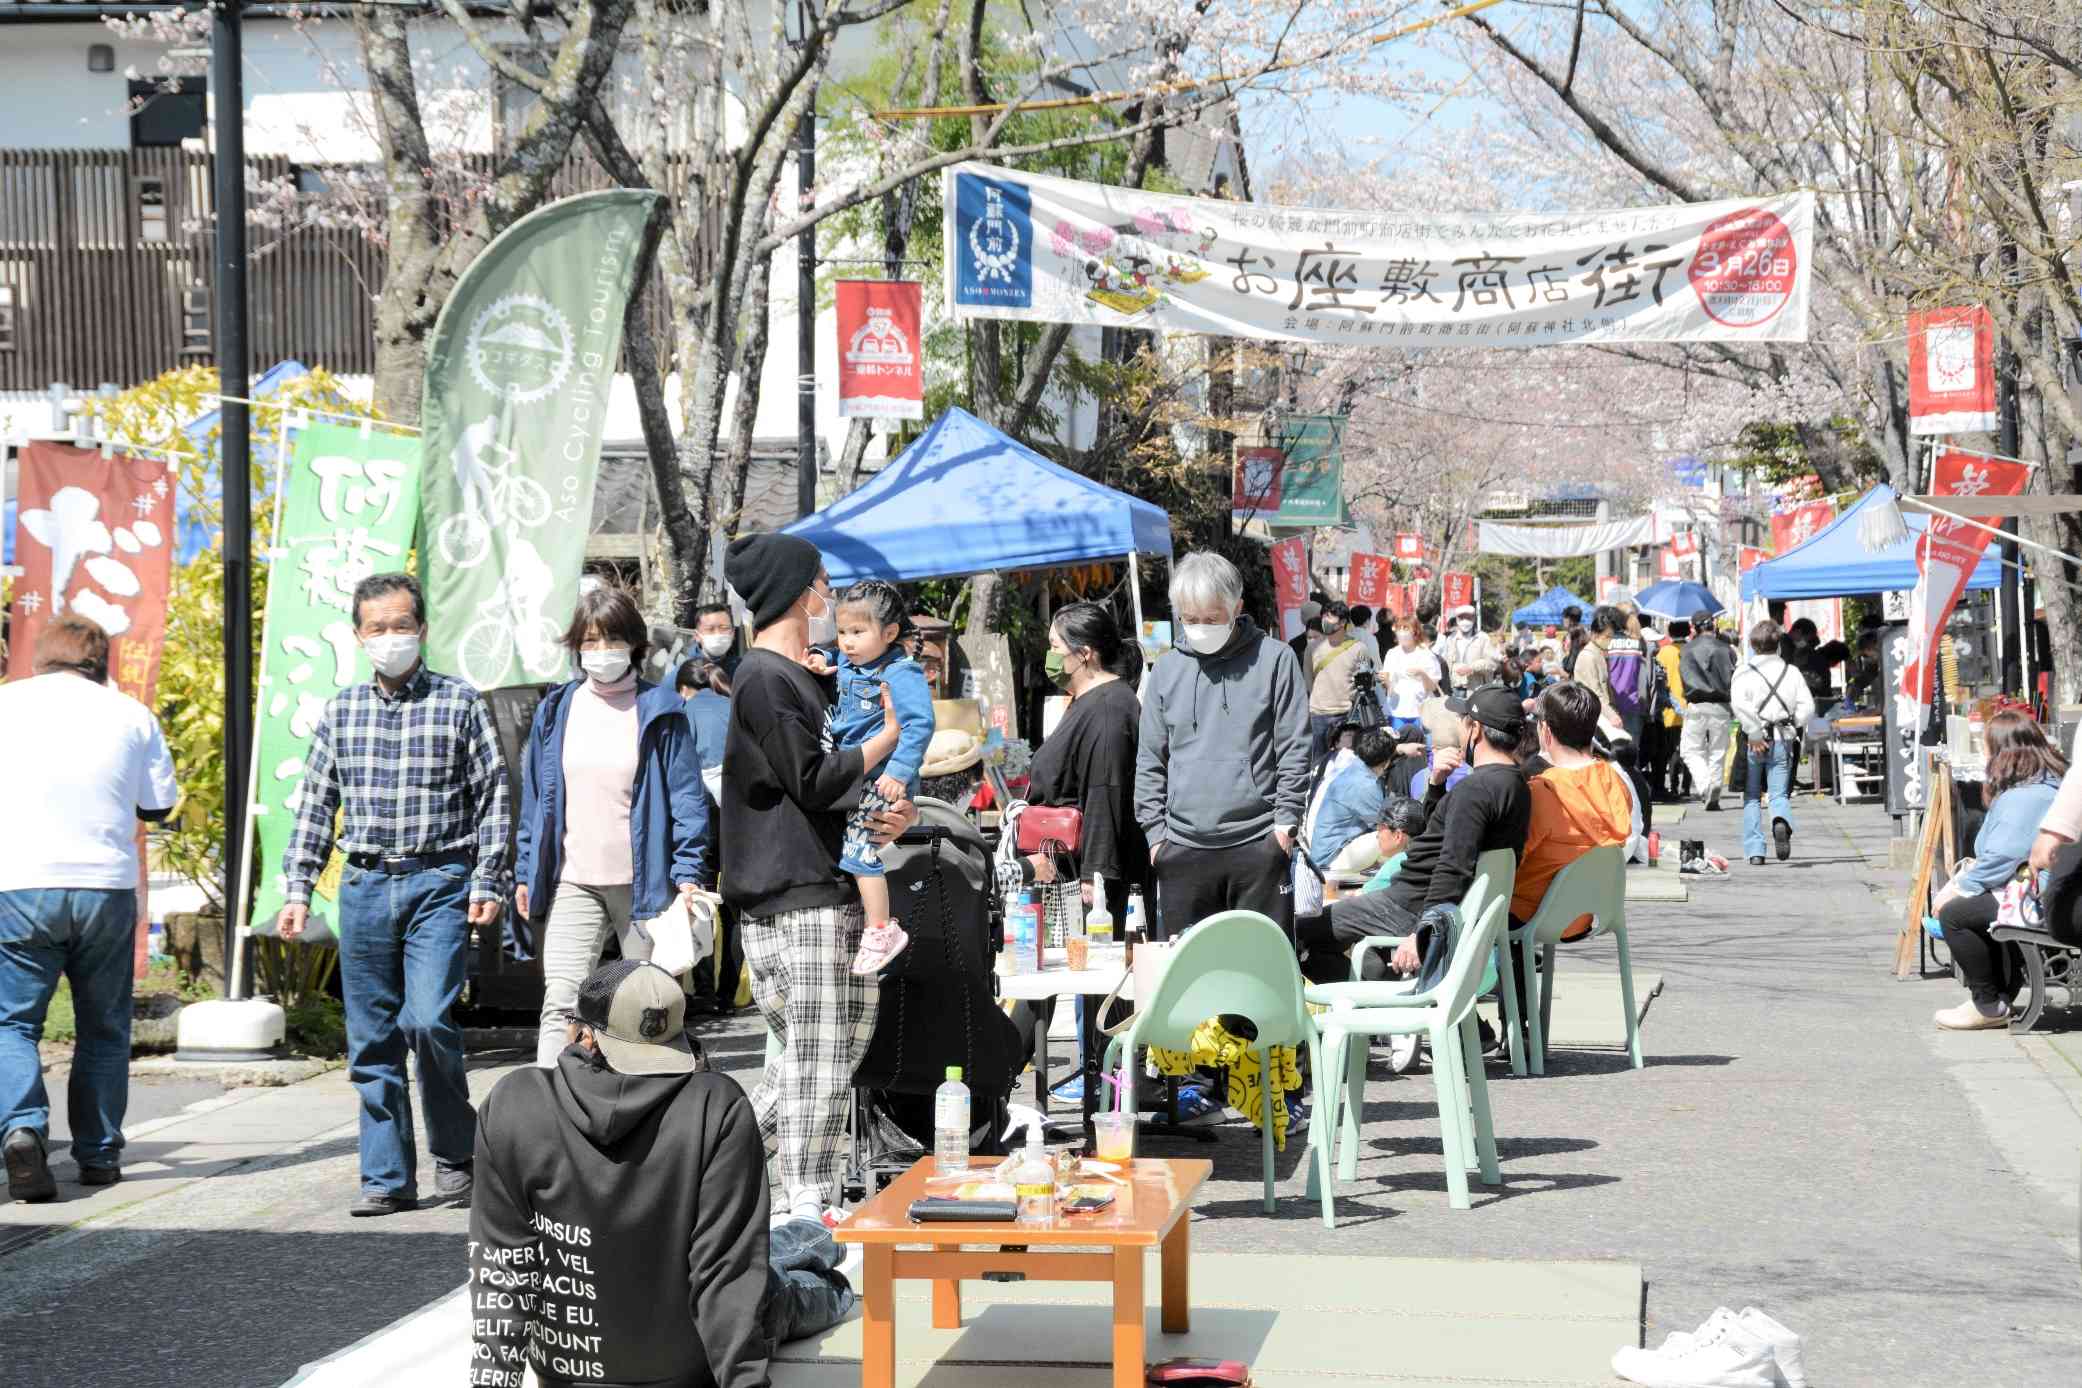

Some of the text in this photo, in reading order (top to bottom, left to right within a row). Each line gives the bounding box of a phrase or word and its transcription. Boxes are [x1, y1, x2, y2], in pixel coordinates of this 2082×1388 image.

[1695, 250, 1790, 277] 3月26日
[1226, 242, 1685, 313] お座敷商店街
[554, 229, 628, 522] Aso Cycling Tourism
[557, 1248, 595, 1275] VEL
[476, 1292, 514, 1309] LEO
[566, 1305, 599, 1327] EU.
[552, 1356, 604, 1379] QUIS
